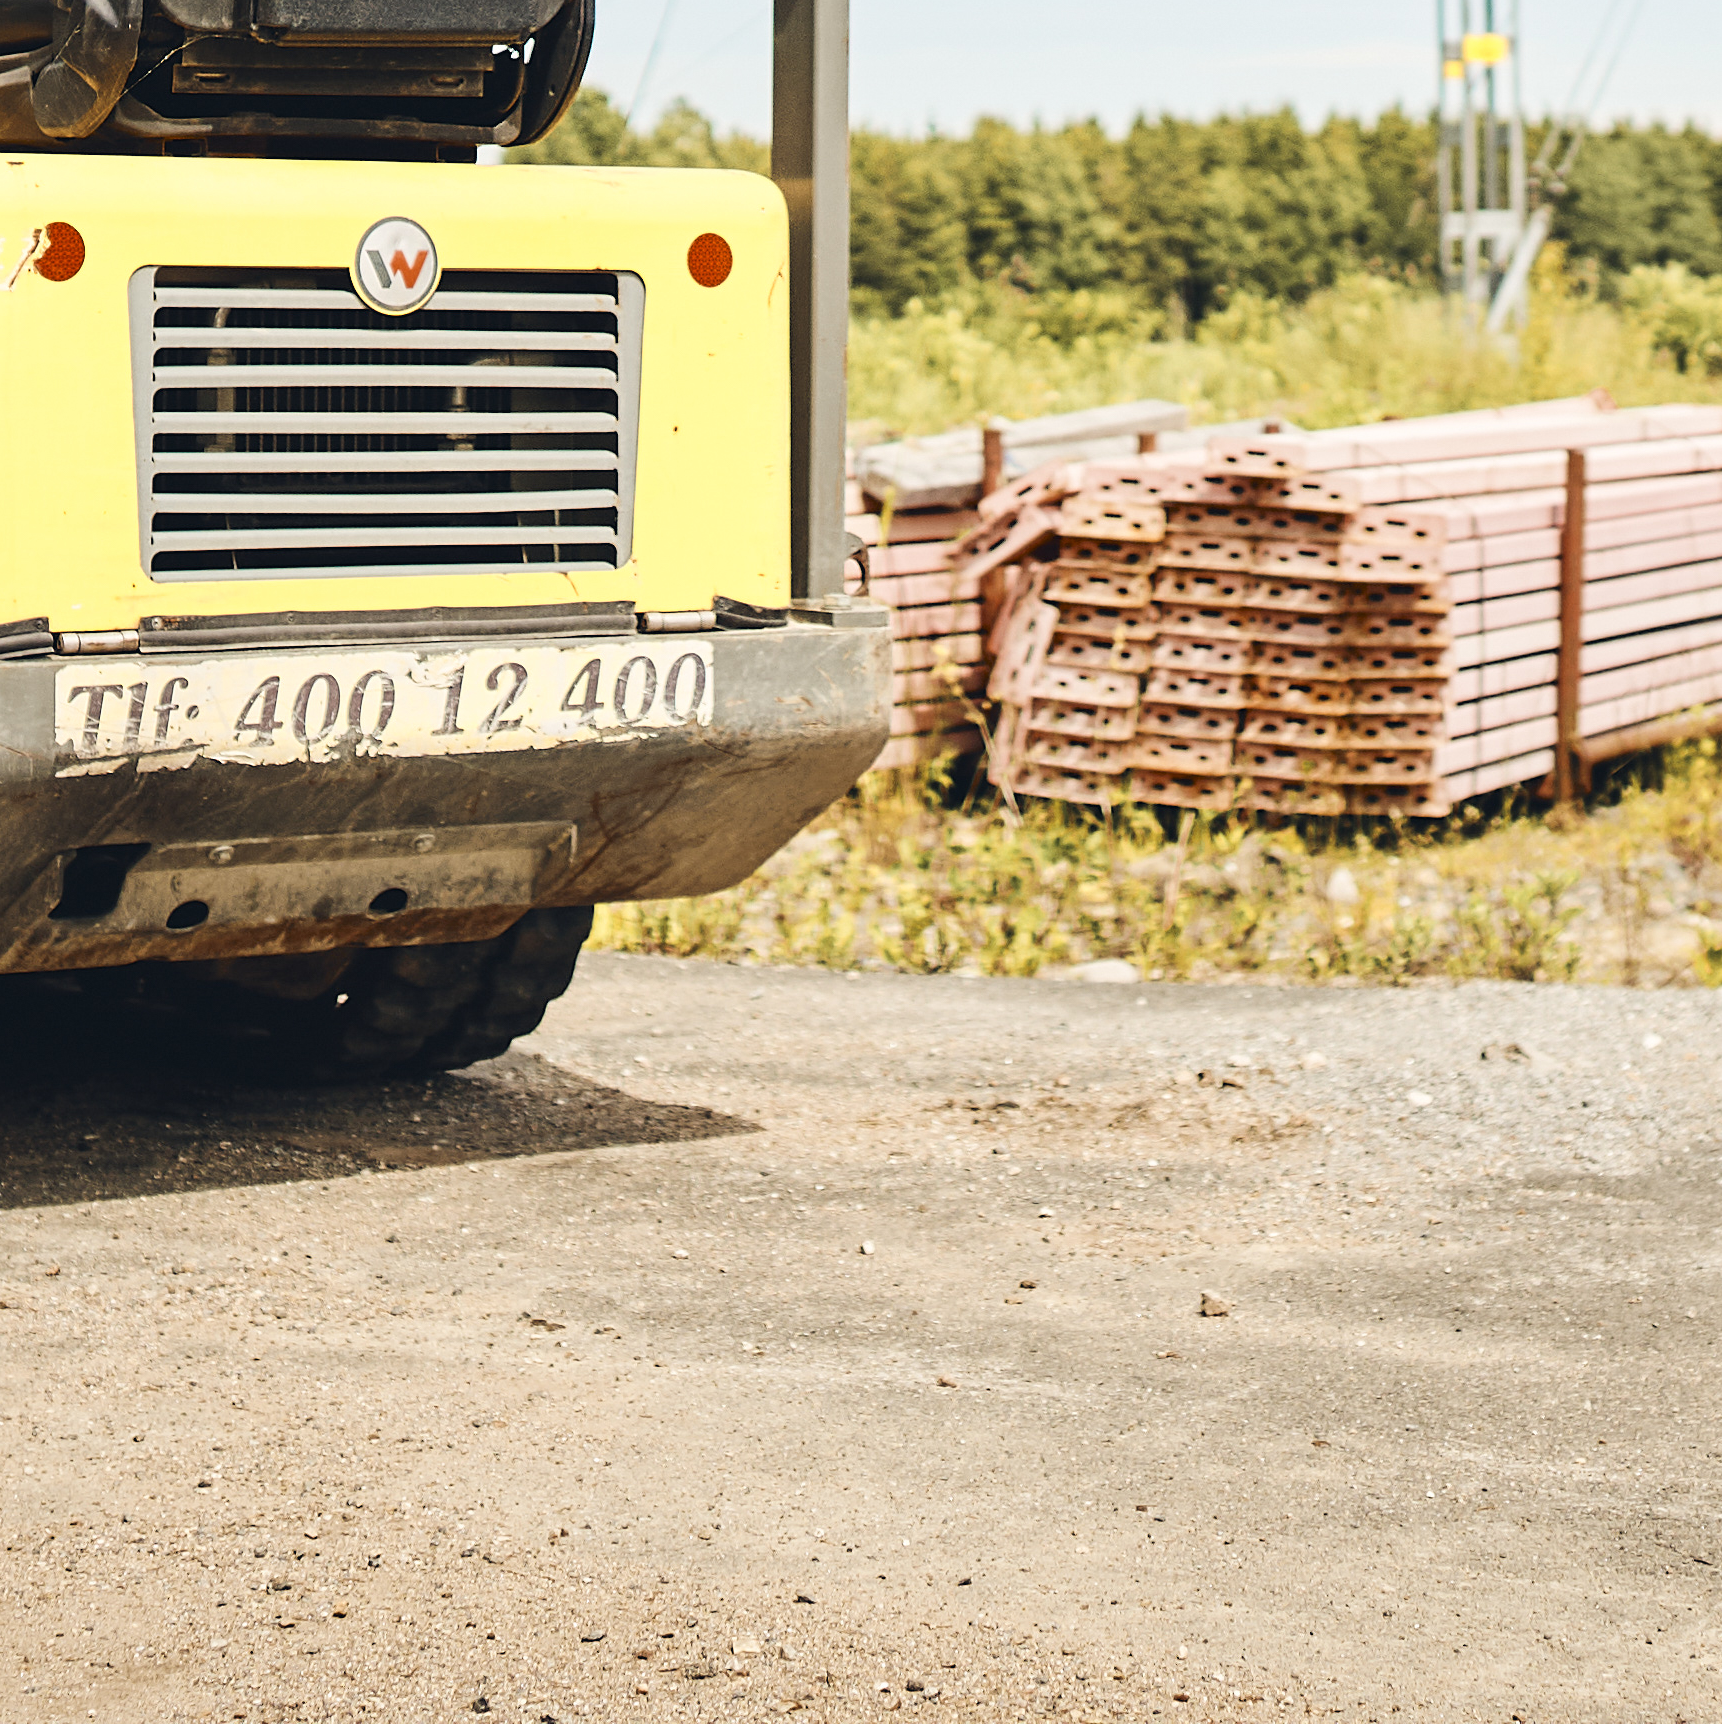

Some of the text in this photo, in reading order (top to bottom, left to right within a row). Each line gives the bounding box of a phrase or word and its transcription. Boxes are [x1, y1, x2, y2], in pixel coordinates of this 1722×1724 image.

[67, 652, 706, 758] Tlf: 400 12 400
